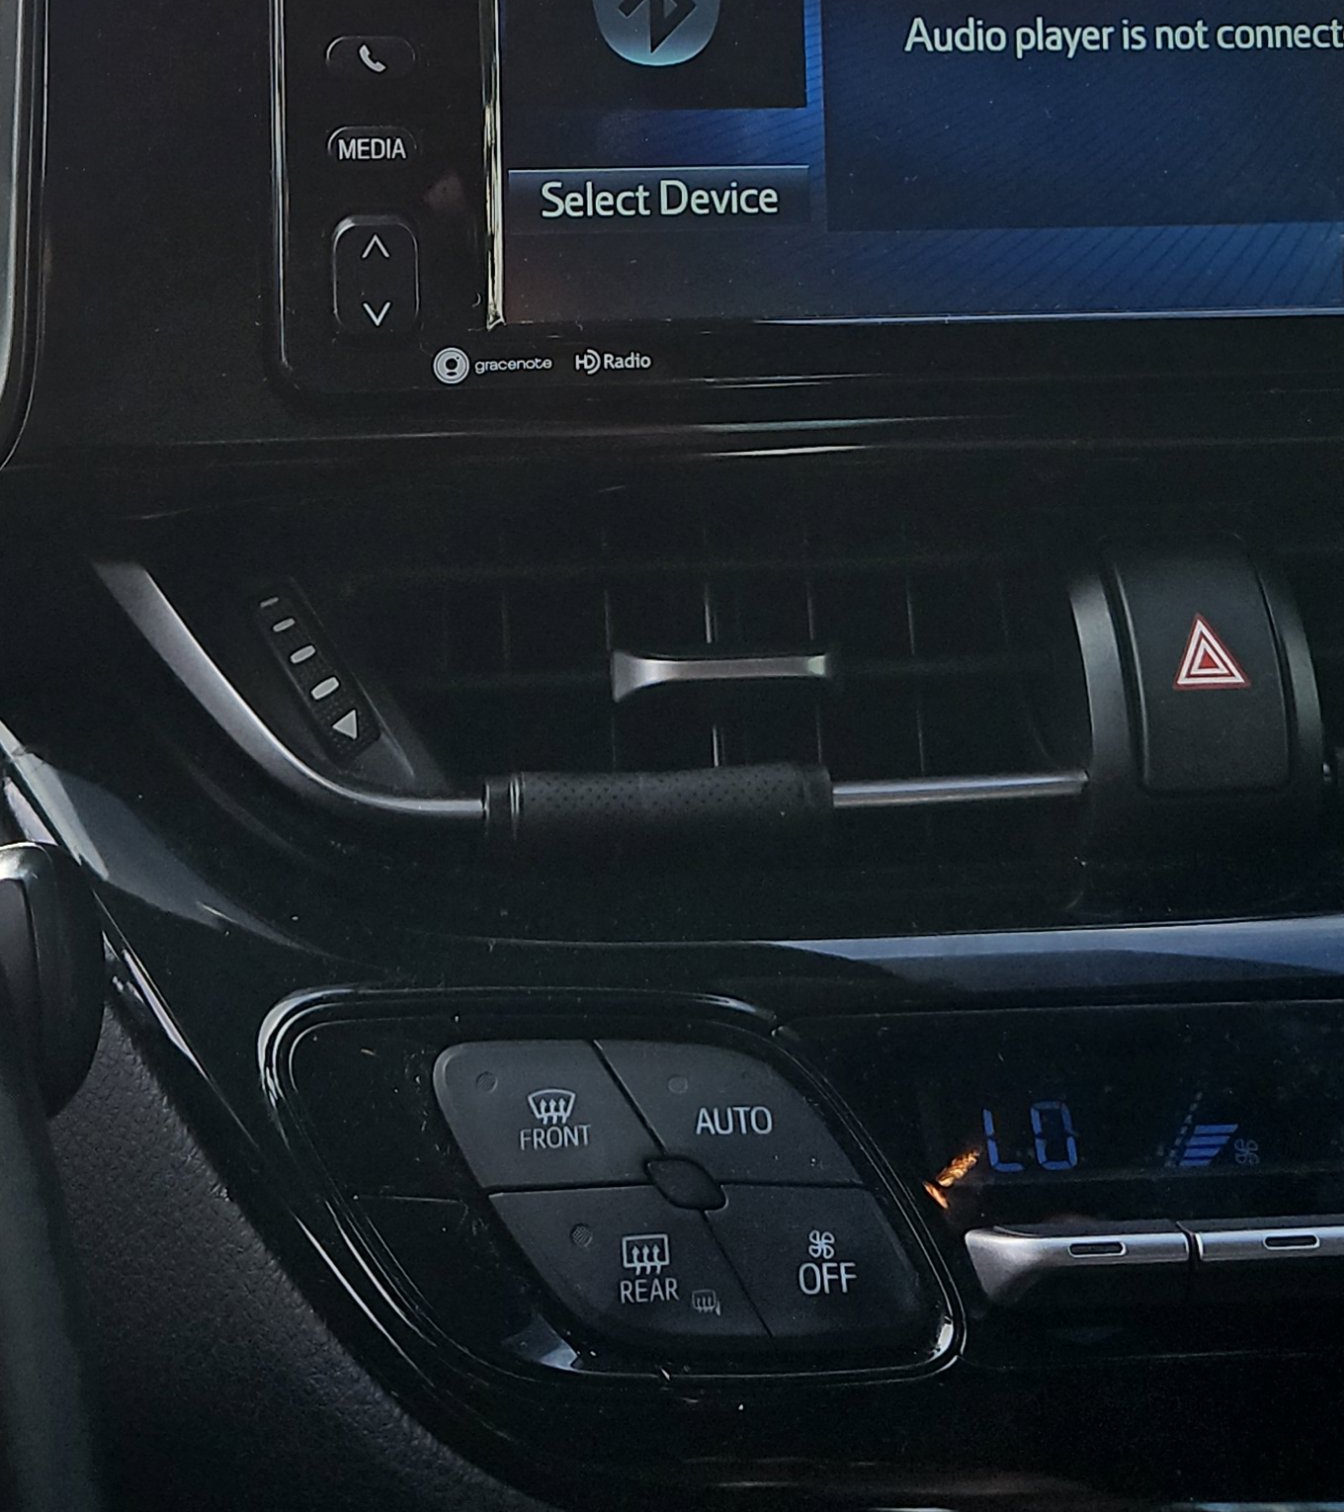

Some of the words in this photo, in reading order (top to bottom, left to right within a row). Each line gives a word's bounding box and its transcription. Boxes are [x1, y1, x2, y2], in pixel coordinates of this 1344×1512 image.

[904, 16, 1007, 53] Audio
[1015, 16, 1114, 59] player
[1121, 19, 1146, 51] is
[1155, 21, 1209, 51] not
[338, 137, 406, 161] MEDIA
[541, 180, 650, 219] Select
[659, 178, 779, 216] Device
[474, 357, 553, 375] gracenote
[604, 351, 652, 370] Radio
[695, 1105, 774, 1135] AUTO
[519, 1124, 592, 1151] FRONT
[619, 1277, 680, 1304] REAR
[798, 1261, 857, 1295] OFF
